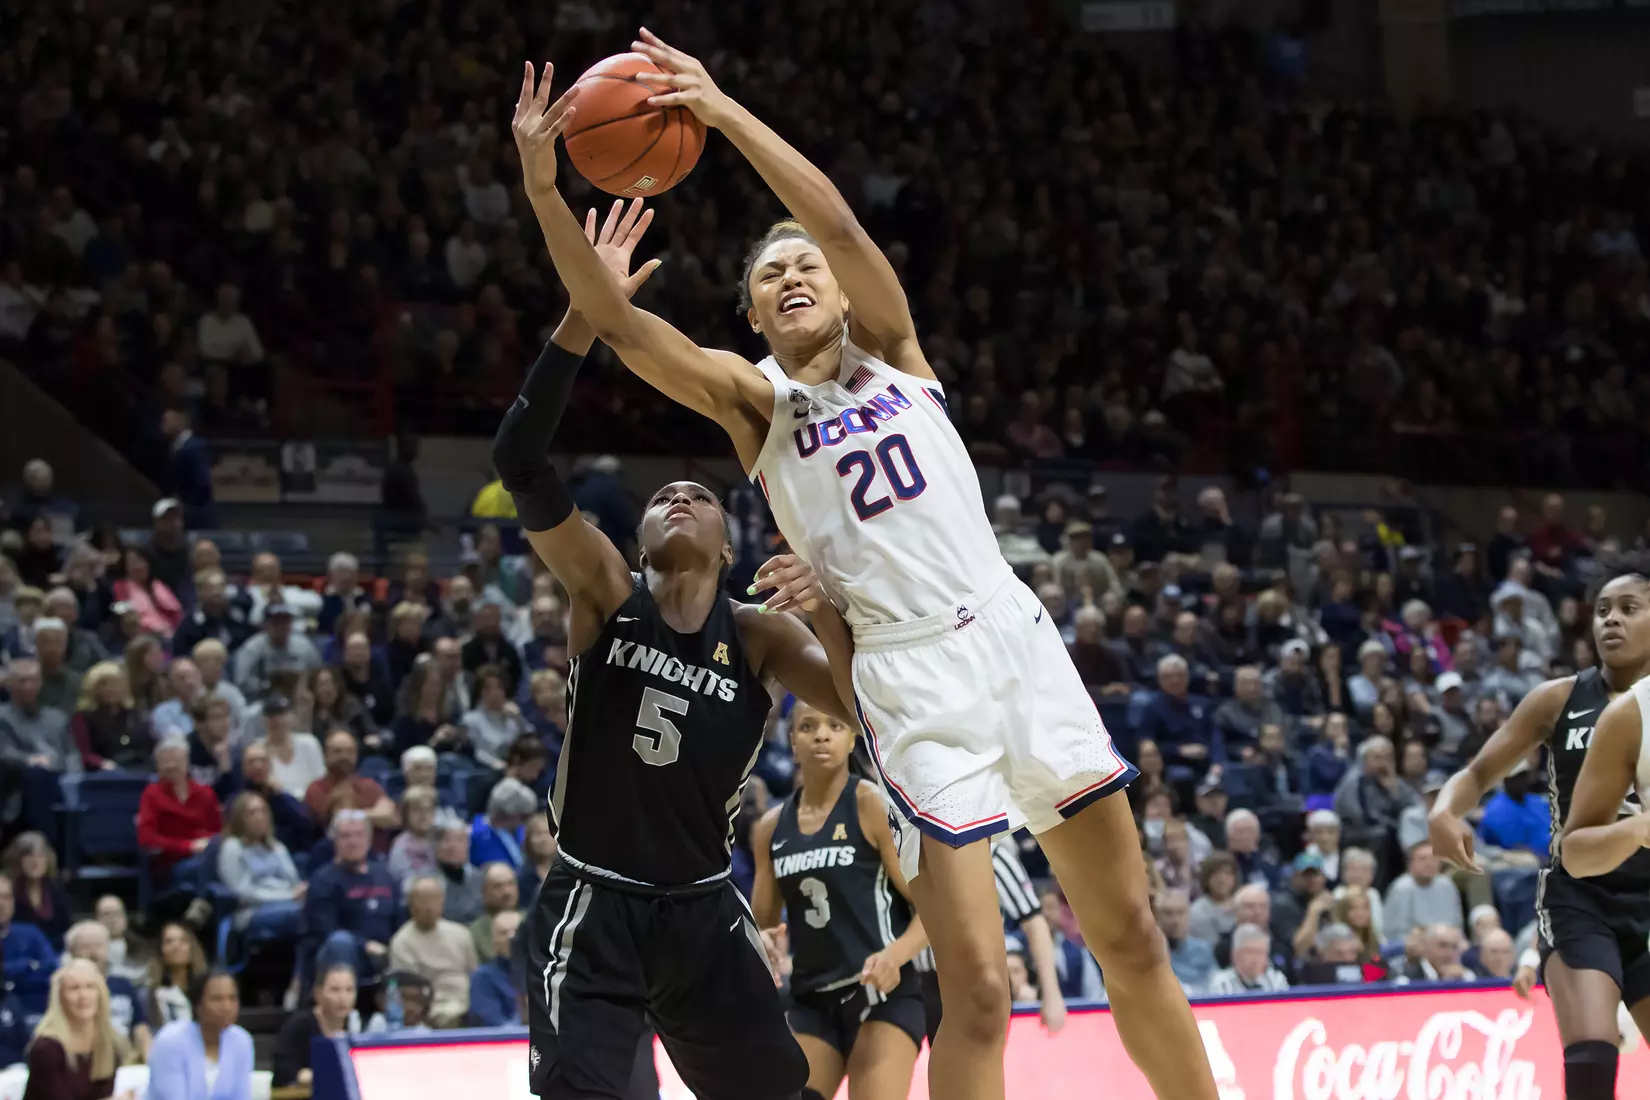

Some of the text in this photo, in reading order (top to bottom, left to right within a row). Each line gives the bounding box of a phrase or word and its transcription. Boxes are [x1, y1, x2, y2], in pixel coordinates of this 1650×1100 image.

[794, 384, 912, 458] UCONN
[836, 434, 927, 521] 20
[954, 614, 976, 630] UCONN
[606, 638, 738, 702] KNIGHTS
[632, 686, 689, 766] 5
[774, 846, 856, 879] KNIGHTS
[799, 877, 830, 929] 3
[1273, 1008, 1542, 1100] Coca-Cola
